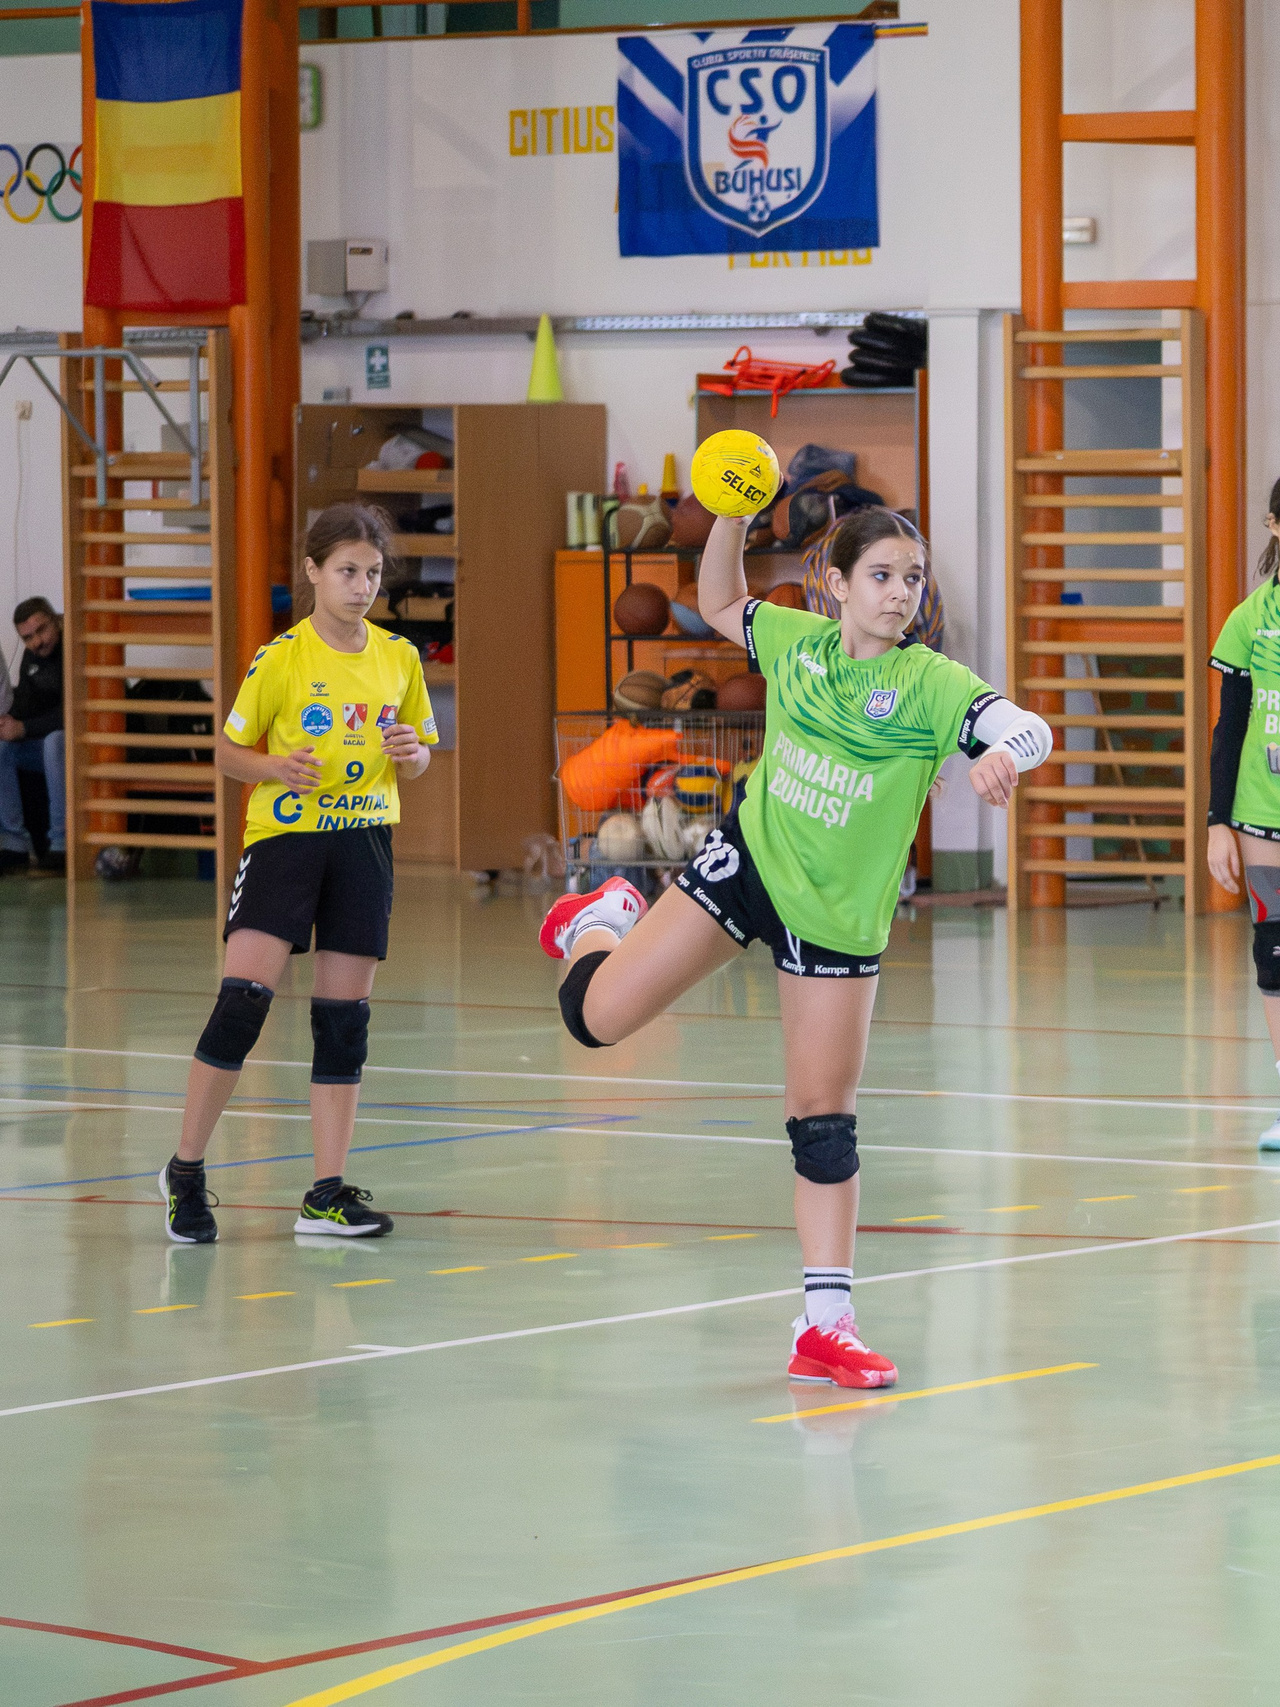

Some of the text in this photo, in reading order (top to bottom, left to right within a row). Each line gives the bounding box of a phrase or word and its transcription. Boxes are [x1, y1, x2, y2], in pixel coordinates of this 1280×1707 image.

[706, 65, 807, 116] CSO
[509, 105, 615, 157] CITIUS
[721, 469, 767, 506] SELECT
[797, 651, 828, 677] Kempa
[958, 718, 972, 745] Kempa
[343, 760, 365, 785] 9
[771, 730, 874, 802] PRIMĂRIA
[317, 793, 389, 811] CAPITAL
[692, 886, 722, 917] Kempa
[724, 917, 746, 941] Kempa
[814, 964, 850, 977] Kempa
